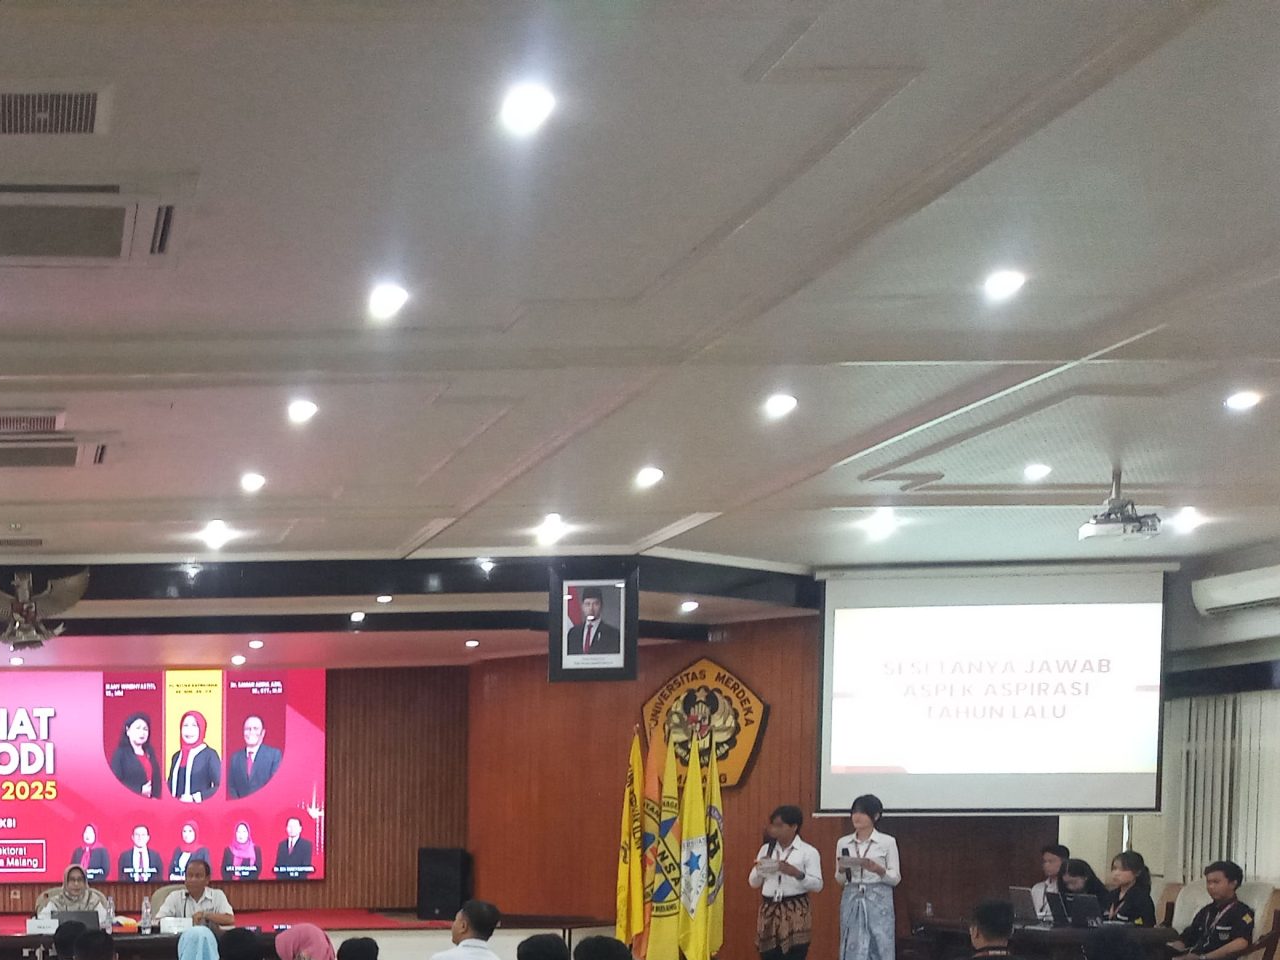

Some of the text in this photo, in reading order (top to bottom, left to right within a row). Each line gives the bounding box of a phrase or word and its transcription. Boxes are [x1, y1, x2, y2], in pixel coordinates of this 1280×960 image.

[1024, 658, 1112, 674] JAWAB
[984, 681, 1090, 696] ASPIRASI
[715, 671, 755, 727] MERDEKA
[1011, 704, 1067, 719] LALU
[1, 780, 57, 800] 2025
[6, 857, 39, 868] Malang
